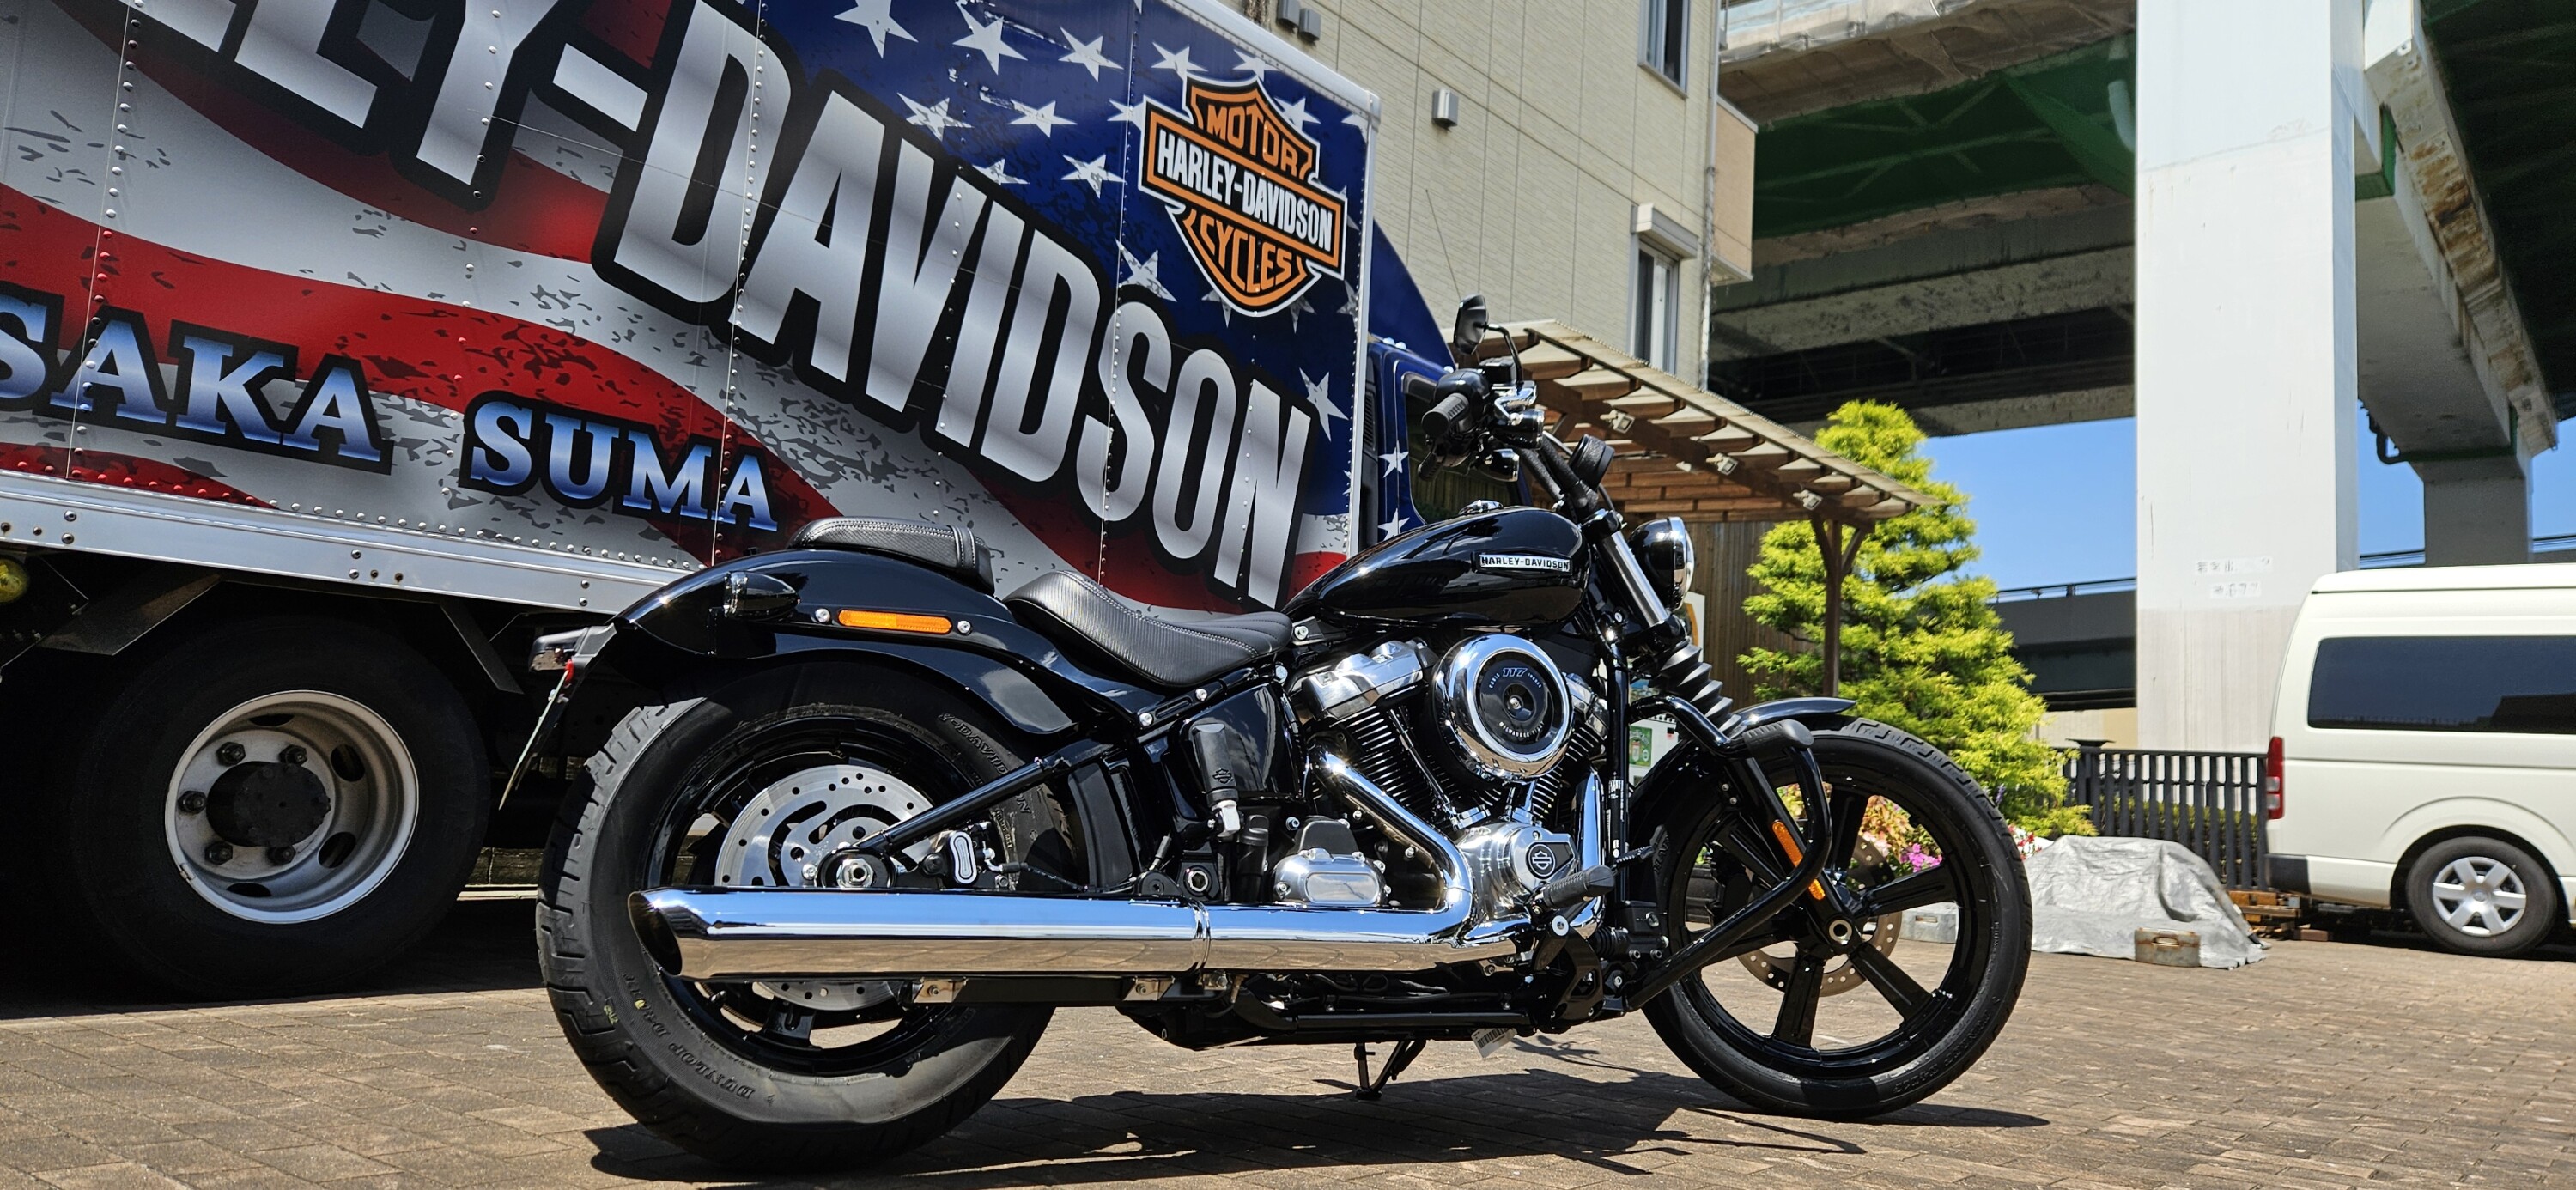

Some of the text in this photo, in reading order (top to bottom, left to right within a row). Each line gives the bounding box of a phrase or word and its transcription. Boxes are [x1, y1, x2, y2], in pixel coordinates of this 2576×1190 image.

[1206, 102, 1298, 178] MOTOR
[1157, 129, 1333, 252] HARLEY-DAVIDSON
[1200, 214, 1292, 293] CYCLES
[470, 401, 778, 531] SUMA
[1481, 556, 1570, 571] HARLEY-DAVIDSON
[1502, 667, 1528, 677] 117
[668, 1042, 756, 1100] DUNLOP
